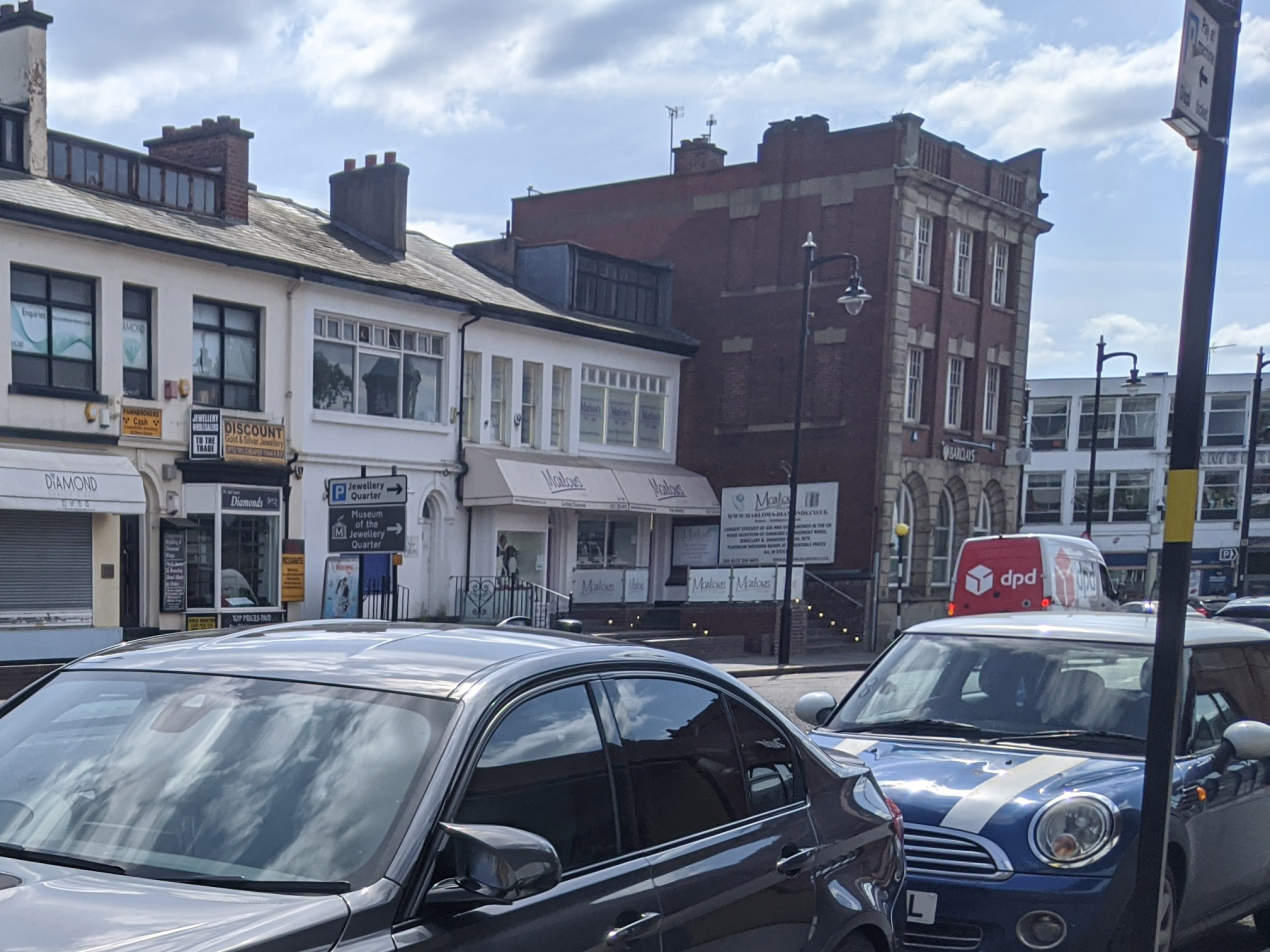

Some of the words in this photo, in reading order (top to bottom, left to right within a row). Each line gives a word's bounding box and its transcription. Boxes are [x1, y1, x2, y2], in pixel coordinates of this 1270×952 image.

[22, 307, 46, 320] Enquiries
[133, 416, 148, 426] Cash
[192, 414, 219, 422] JEWELLERY
[224, 422, 283, 439] DISCOUNT
[206, 436, 216, 444] THE
[225, 434, 238, 444] Gold
[239, 435, 243, 444] &
[244, 436, 259, 445] Silver
[260, 438, 284, 450] Jewellery
[196, 444, 214, 452] TRADE
[948, 446, 976, 463] BARCLAYS
[335, 484, 344, 500] P
[348, 482, 384, 490] Jewellery
[350, 492, 382, 500] Quarter
[230, 495, 264, 508] Diamonds
[755, 491, 790, 511] Marlo
[351, 510, 383, 518] Museum
[355, 520, 364, 528] of
[366, 520, 378, 528] the
[349, 530, 385, 540] Jewellery
[352, 540, 382, 549] Quarter
[692, 576, 727, 592] Marlows
[736, 576, 771, 592] Marlows
[1000, 568, 1038, 590] dpd
[1077, 561, 1096, 598] dpd
[243, 614, 260, 622] PRICES
[908, 894, 923, 918] L
